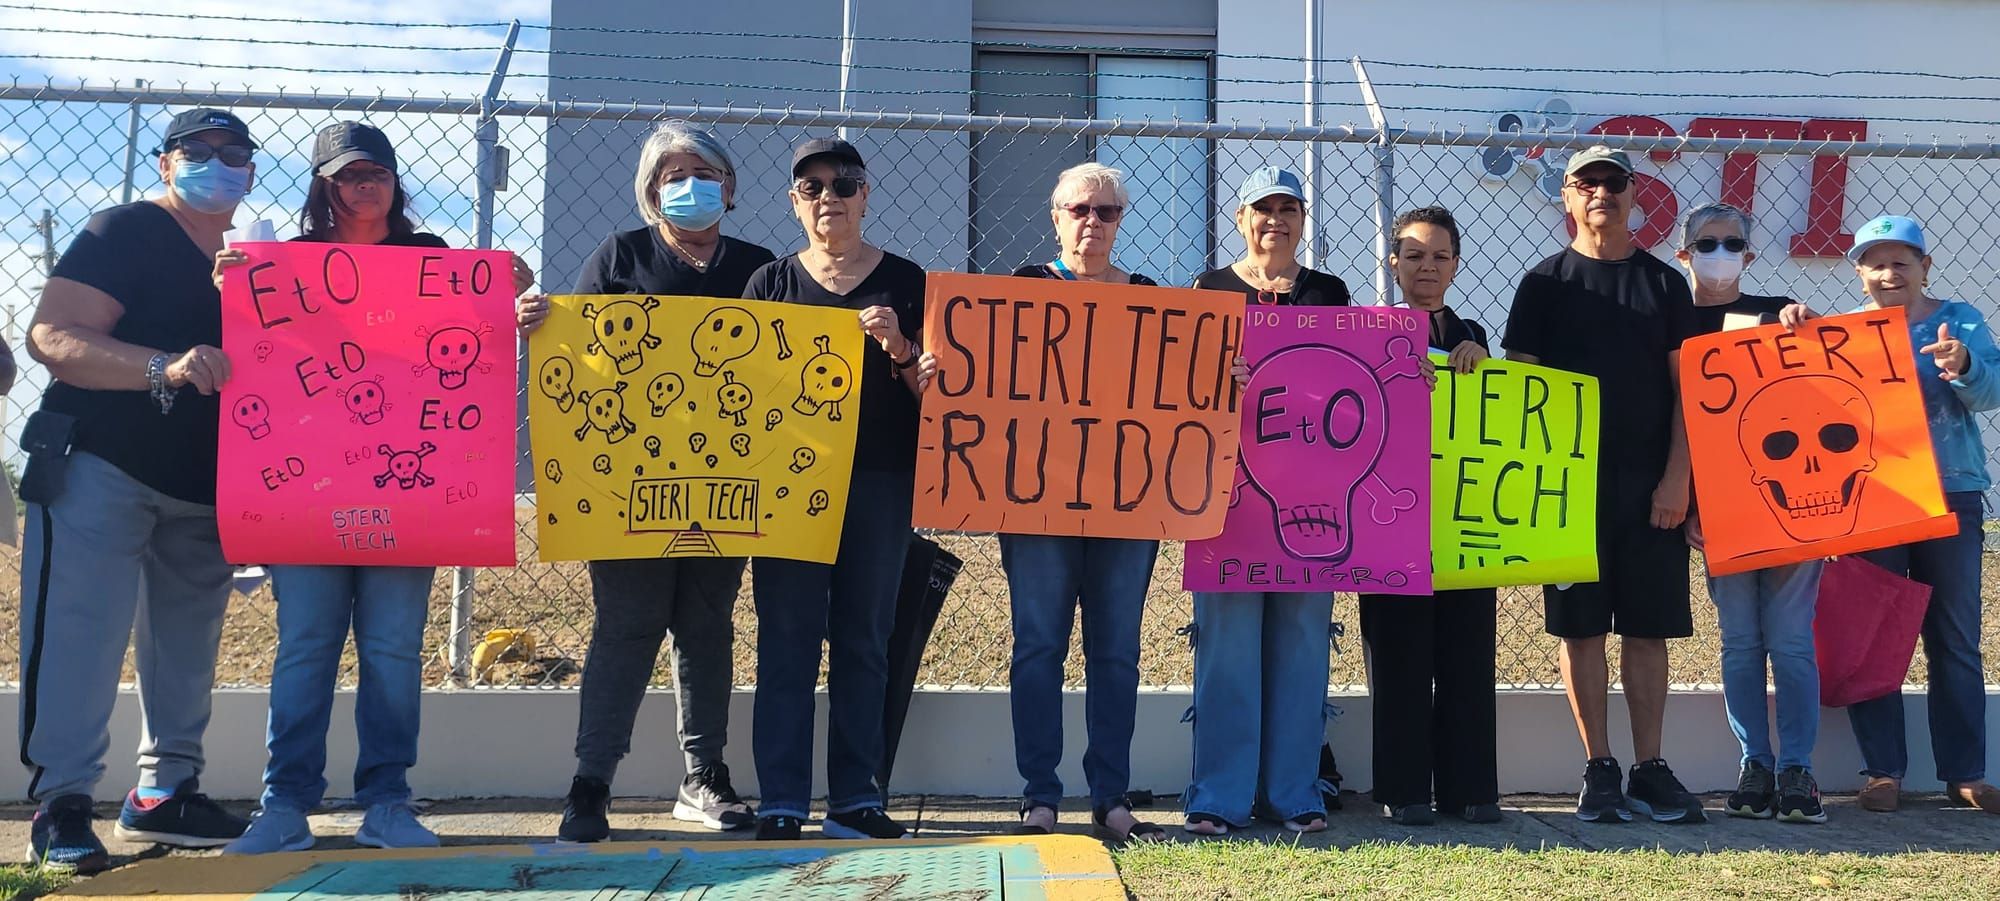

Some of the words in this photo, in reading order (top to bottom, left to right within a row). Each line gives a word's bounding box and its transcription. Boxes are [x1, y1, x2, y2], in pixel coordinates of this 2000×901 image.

[248, 247, 360, 329] EtO
[418, 255, 492, 296] EtO
[1297, 315, 1318, 329] DE
[1336, 313, 1417, 331] ETILENO
[295, 341, 366, 397] EtO
[938, 295, 1097, 406] STERI
[1127, 304, 1242, 413] TECH
[1700, 318, 1906, 415] STERI
[419, 399, 482, 430] EtO
[1256, 386, 1366, 450] EtO
[1435, 365, 1585, 459] TERI
[261, 457, 305, 491] EtO
[344, 446, 371, 465] EtO
[941, 410, 1216, 516] RUIDO
[446, 481, 478, 505] EtO
[635, 483, 690, 522] STERI
[705, 483, 756, 521] TECH
[1431, 453, 1569, 529] ECH
[333, 509, 391, 528] STERI
[335, 531, 397, 550] TECH
[1219, 559, 1408, 588] PELIGRO
